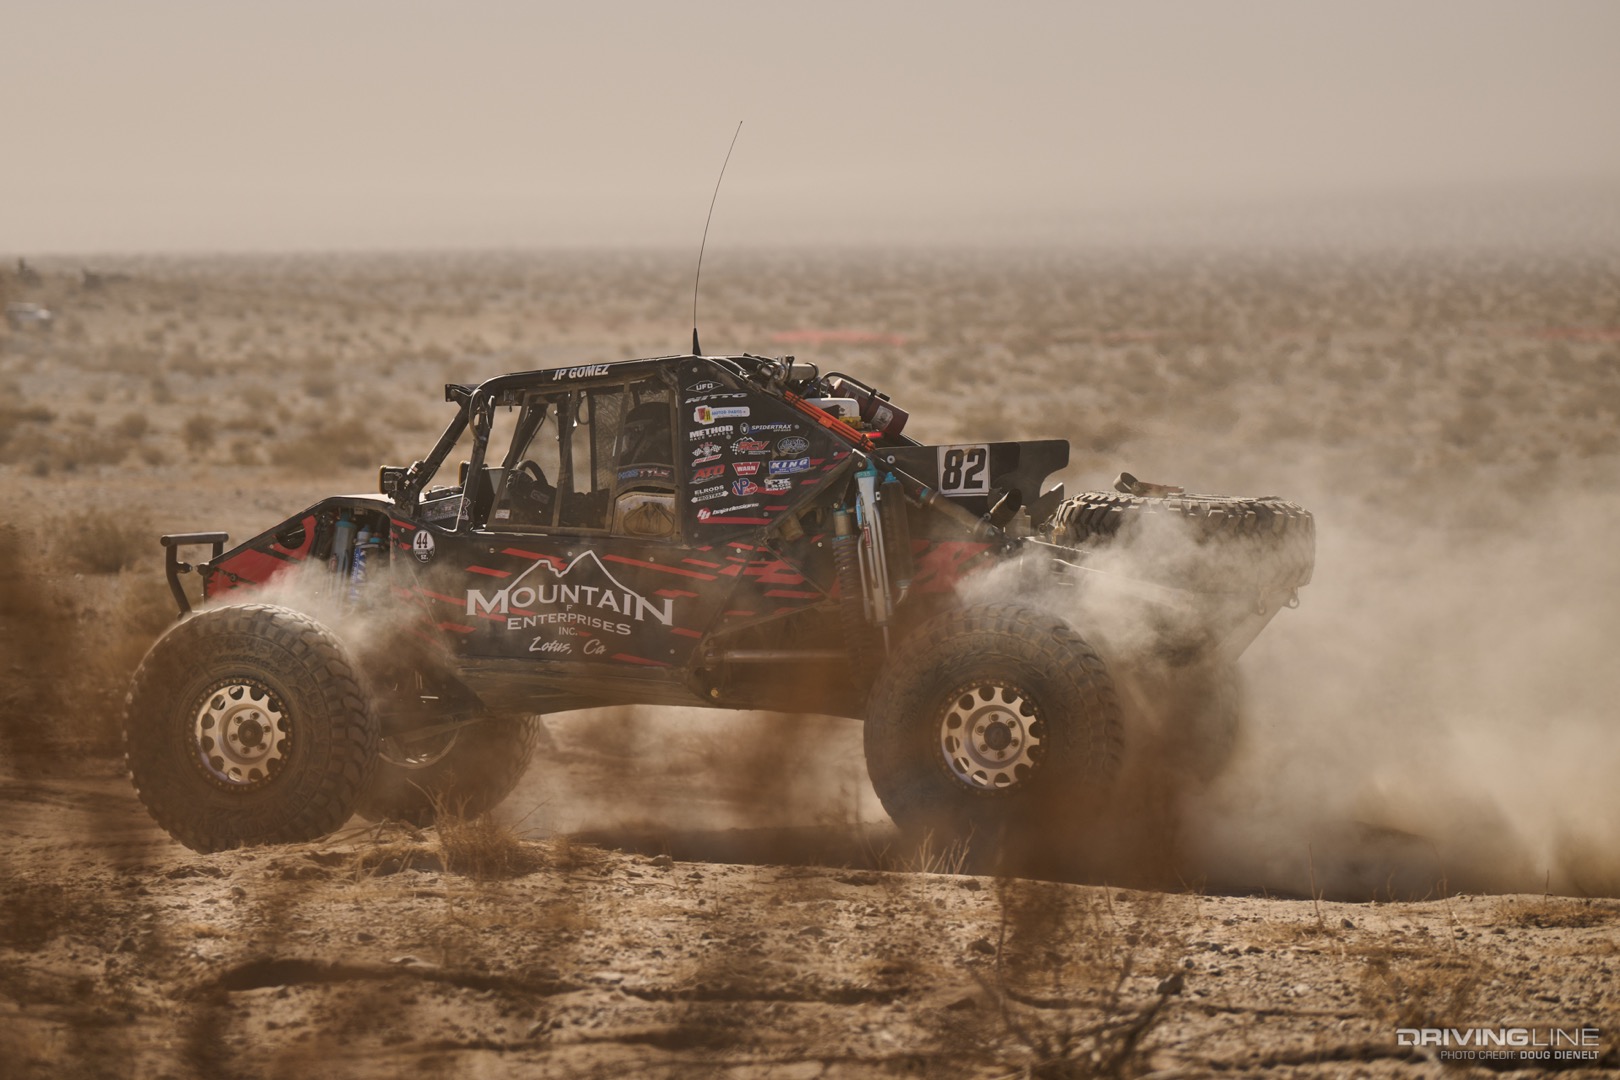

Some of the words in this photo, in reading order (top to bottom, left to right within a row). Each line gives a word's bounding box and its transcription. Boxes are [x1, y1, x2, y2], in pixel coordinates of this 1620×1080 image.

[552, 369, 567, 381] JP
[568, 364, 611, 379] GOMEZ
[685, 393, 747, 404] NITTO
[689, 425, 734, 439] METHOD
[737, 441, 770, 451] RCV
[771, 459, 808, 469] KING
[942, 448, 987, 490] 82
[694, 485, 724, 495] ELRODS
[733, 478, 750, 496] VP
[416, 533, 428, 548] 44
[466, 585, 674, 626] MOUNTAIN
[507, 613, 631, 635] ENTERPRISES
[558, 627, 578, 636] INC.
[529, 636, 573, 655] Lotus,
[583, 639, 607, 655] Ca
